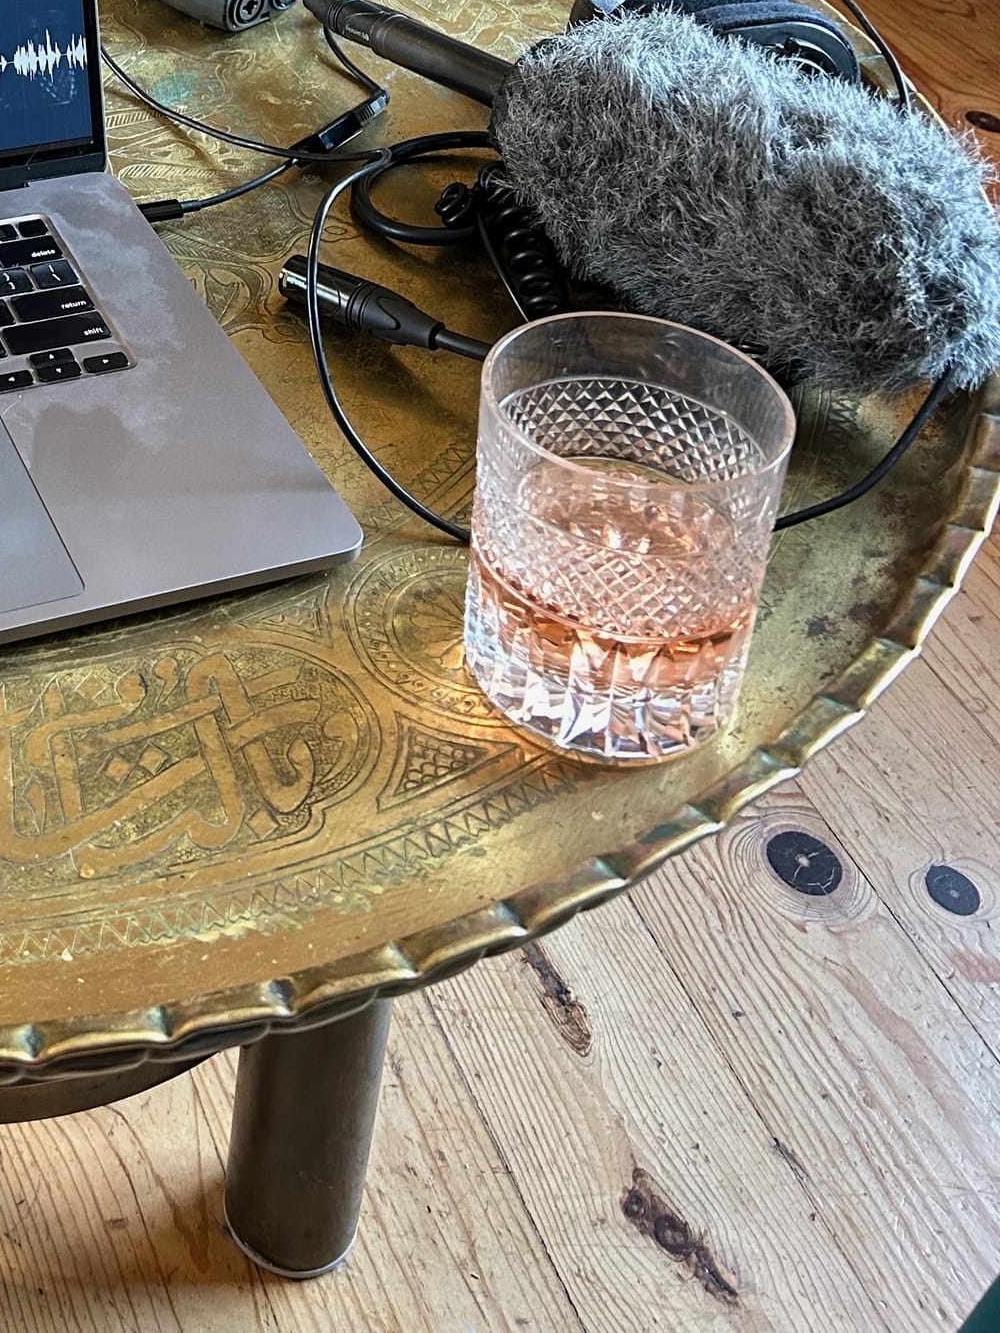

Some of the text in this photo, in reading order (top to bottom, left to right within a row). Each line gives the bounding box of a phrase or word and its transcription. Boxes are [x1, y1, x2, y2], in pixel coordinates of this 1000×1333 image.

[31, 248, 56, 258] delete
[60, 299, 87, 309] return
[83, 326, 104, 337] shift
